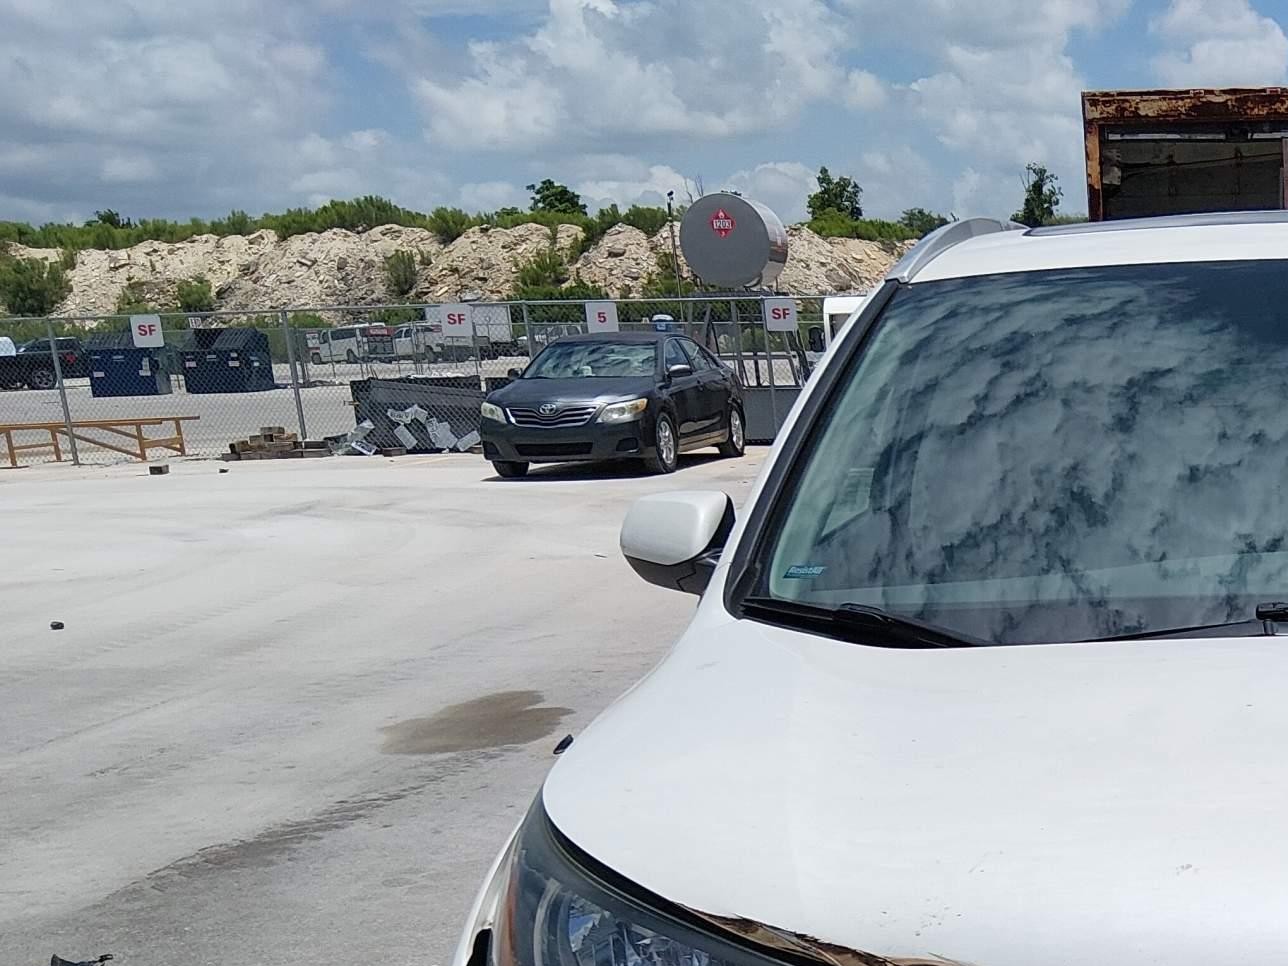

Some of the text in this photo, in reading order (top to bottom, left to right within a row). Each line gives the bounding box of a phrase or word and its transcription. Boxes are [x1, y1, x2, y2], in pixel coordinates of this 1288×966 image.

[447, 313, 466, 325] SF
[596, 311, 607, 323] 5
[771, 307, 791, 320] SF
[137, 324, 157, 336] SF
